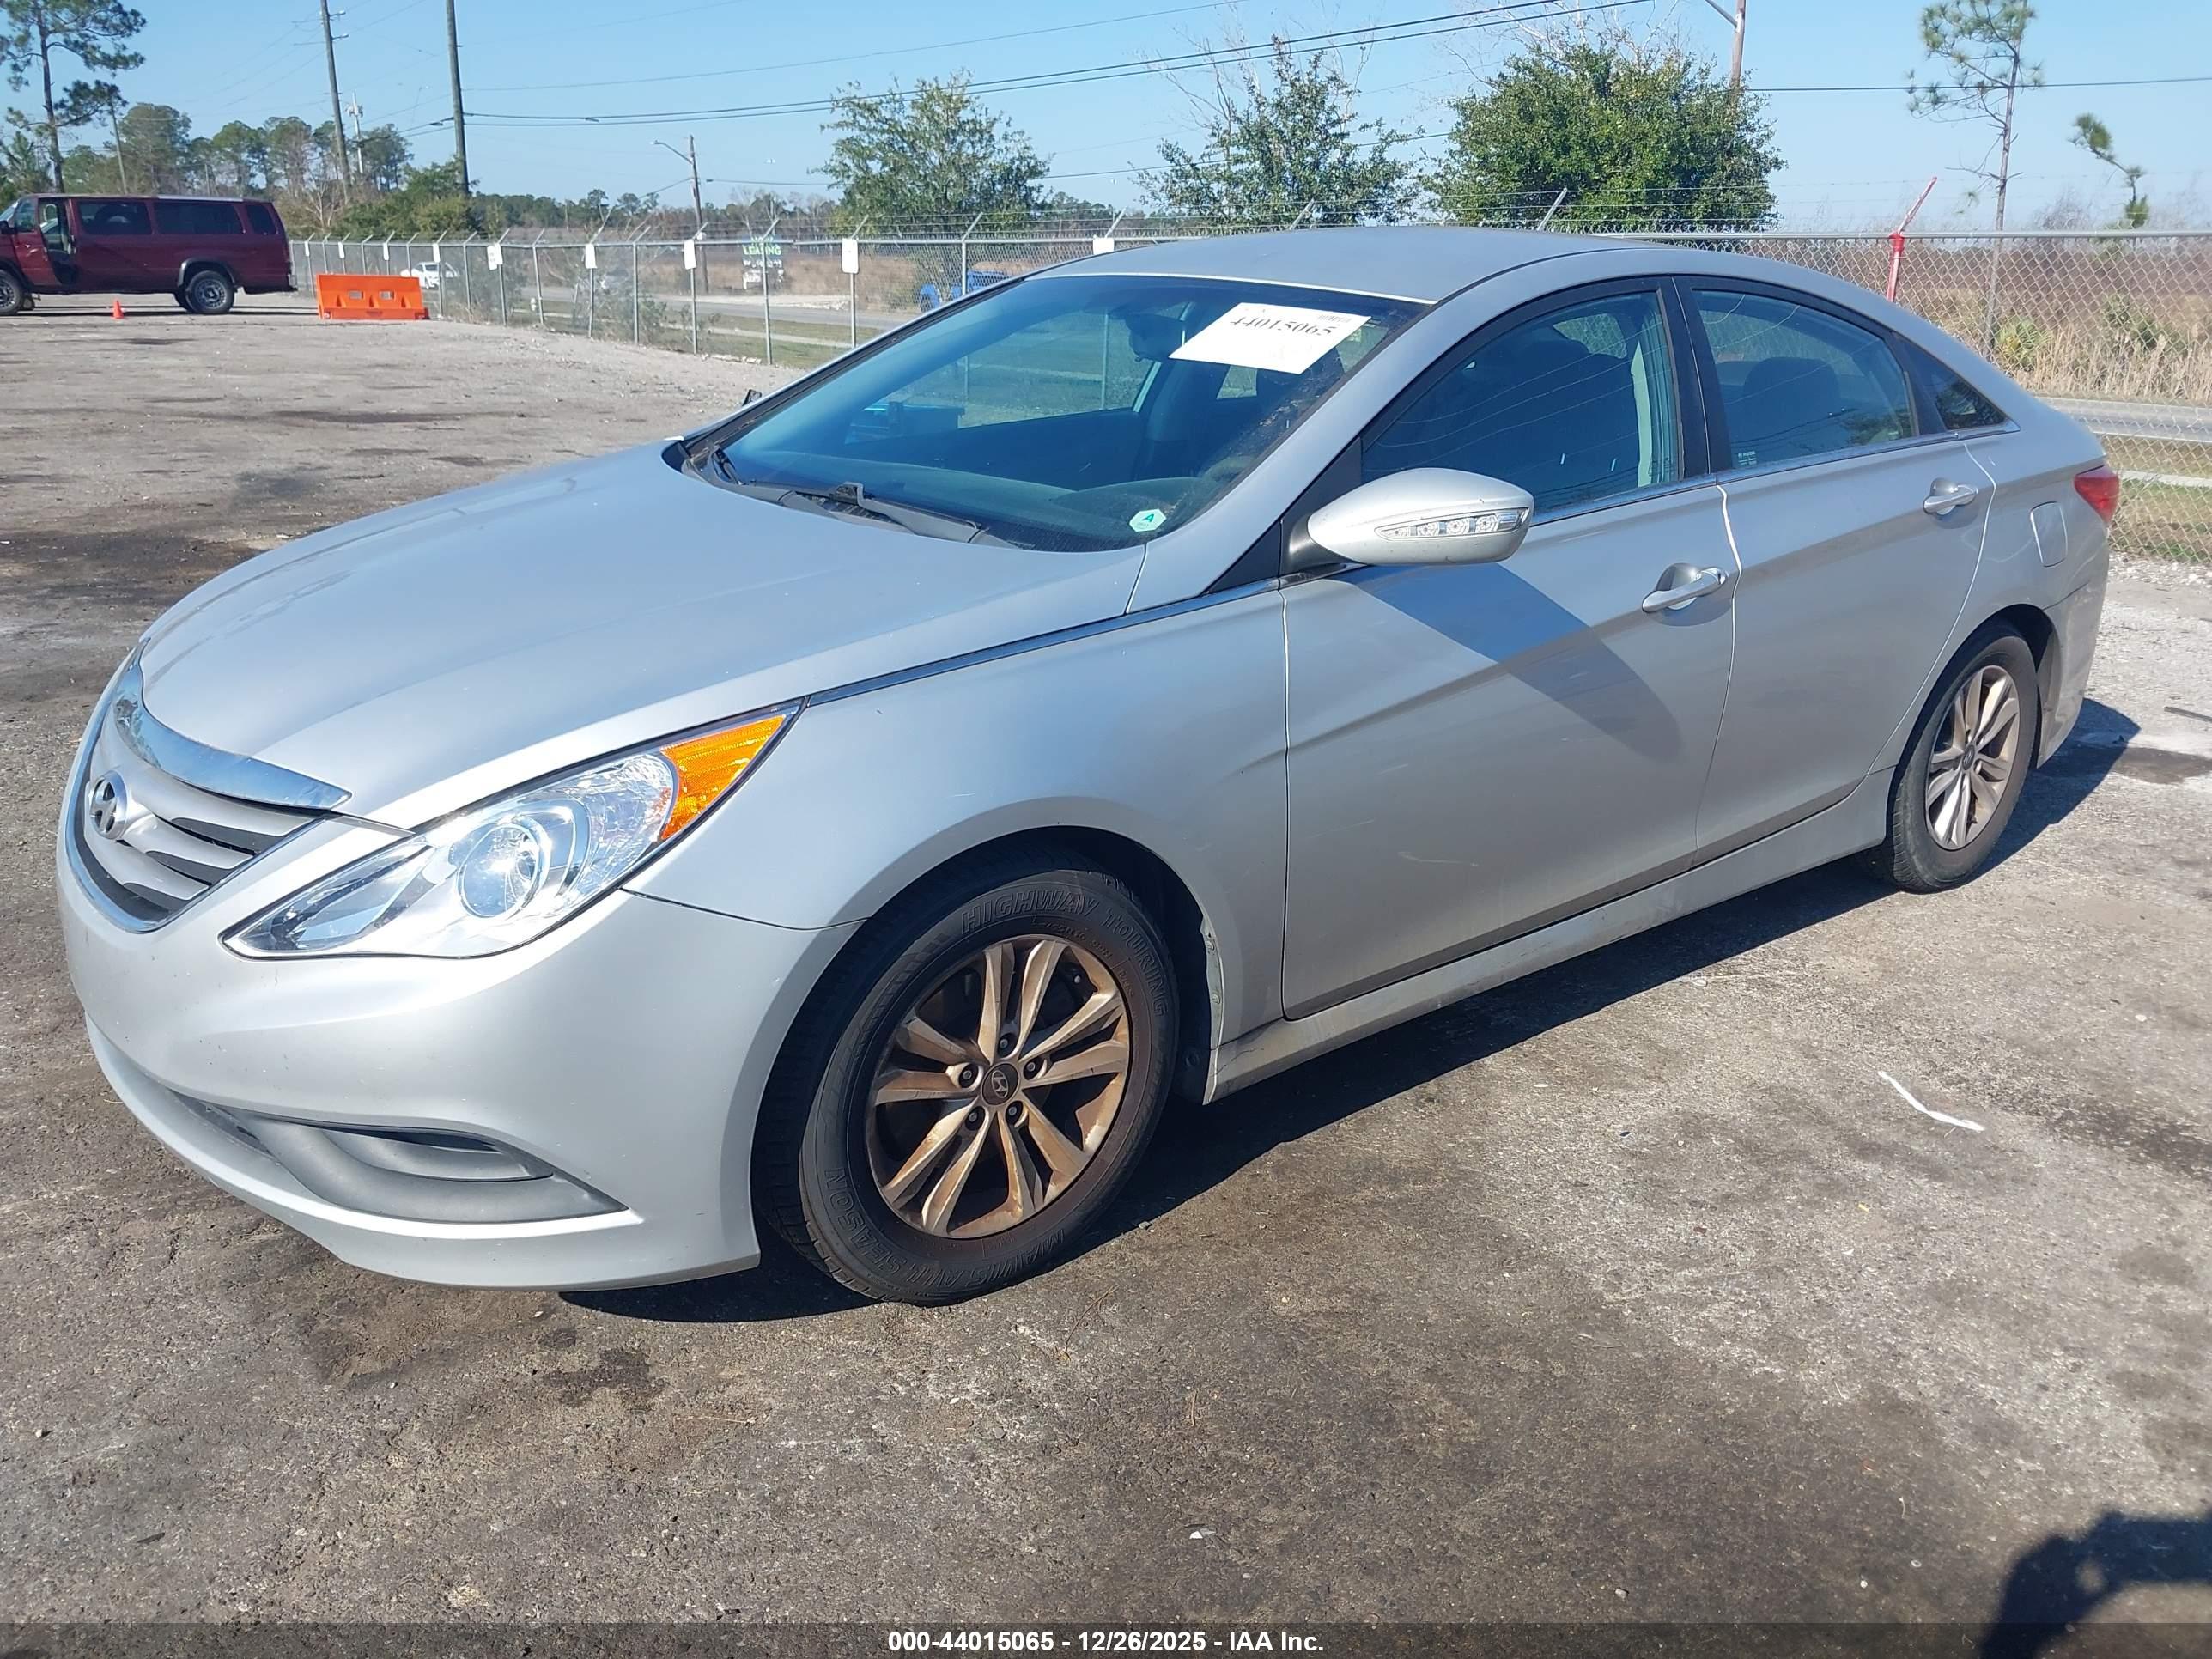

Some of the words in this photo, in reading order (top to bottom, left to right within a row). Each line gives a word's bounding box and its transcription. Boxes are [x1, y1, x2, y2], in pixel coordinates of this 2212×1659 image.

[1230, 316, 1337, 336] 44015065
[961, 890, 1099, 935] HIGHWAY
[1100, 908, 1169, 1018] TOURING
[823, 1167, 903, 1274] SEASON
